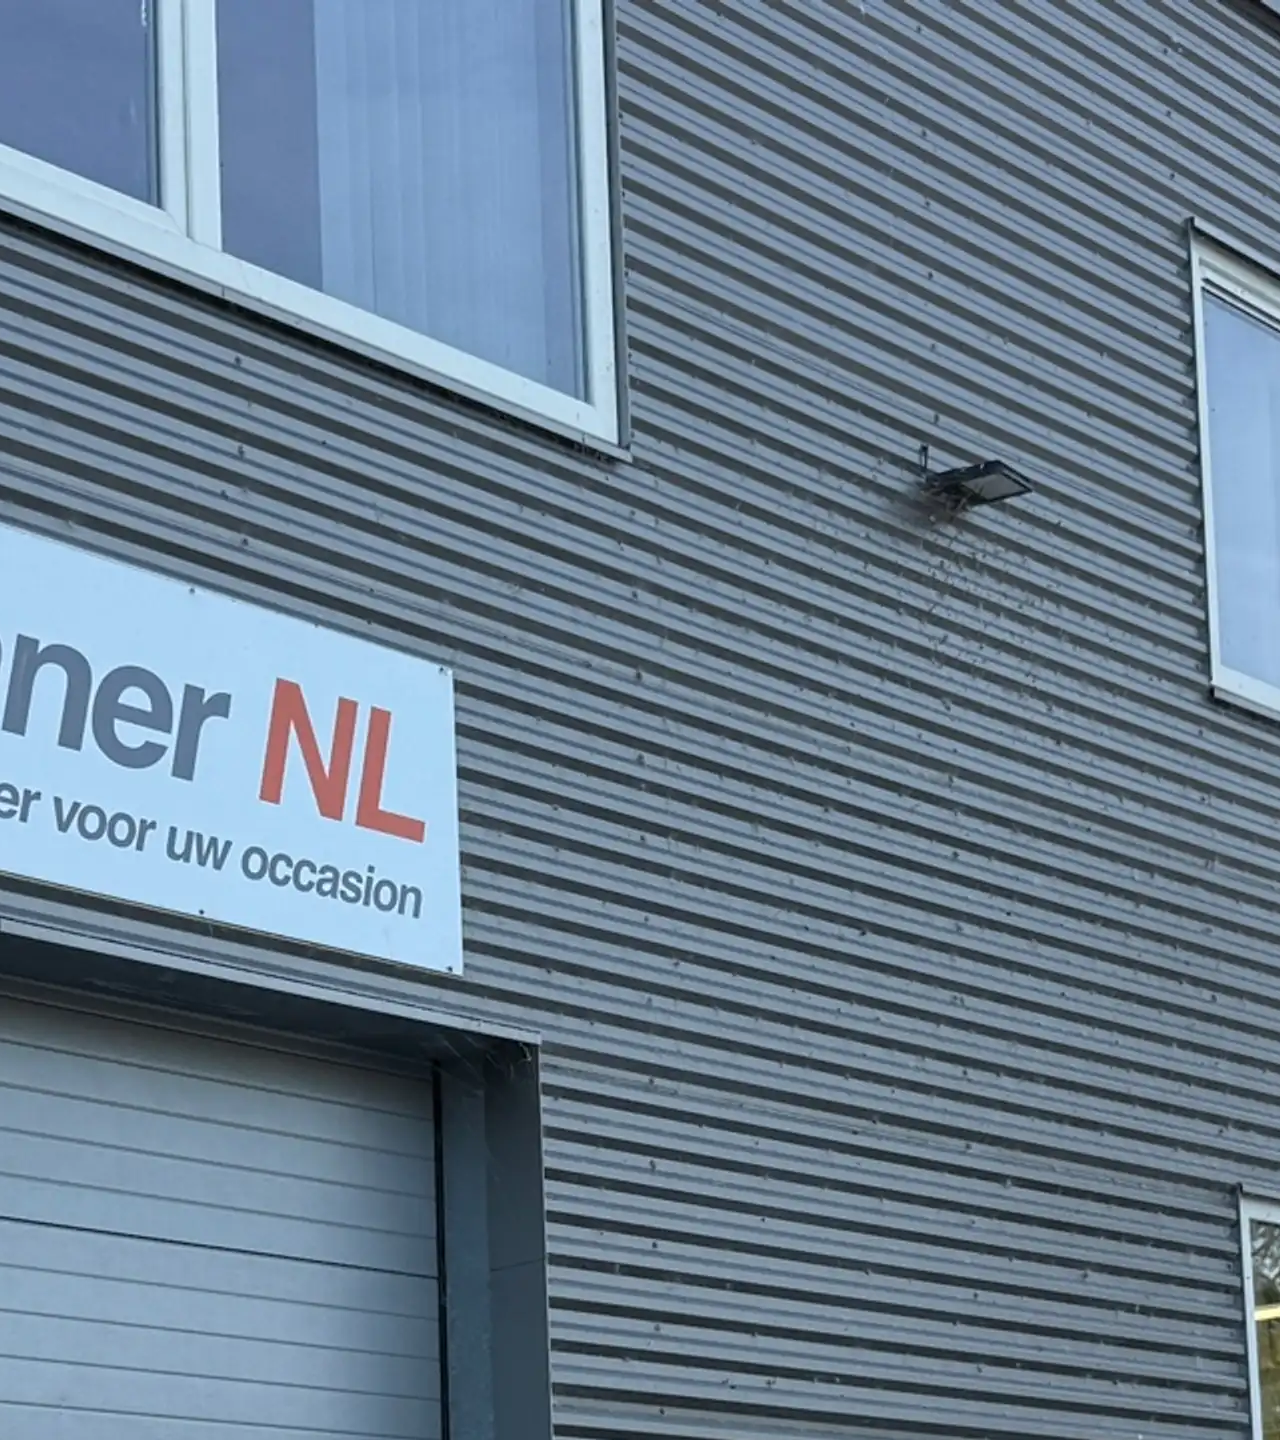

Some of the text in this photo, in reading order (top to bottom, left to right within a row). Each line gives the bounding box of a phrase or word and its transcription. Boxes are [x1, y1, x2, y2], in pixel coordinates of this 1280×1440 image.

[259, 677, 426, 843] NL
[53, 796, 157, 851] voor
[166, 826, 233, 871] uw
[241, 845, 422, 919] occasion
